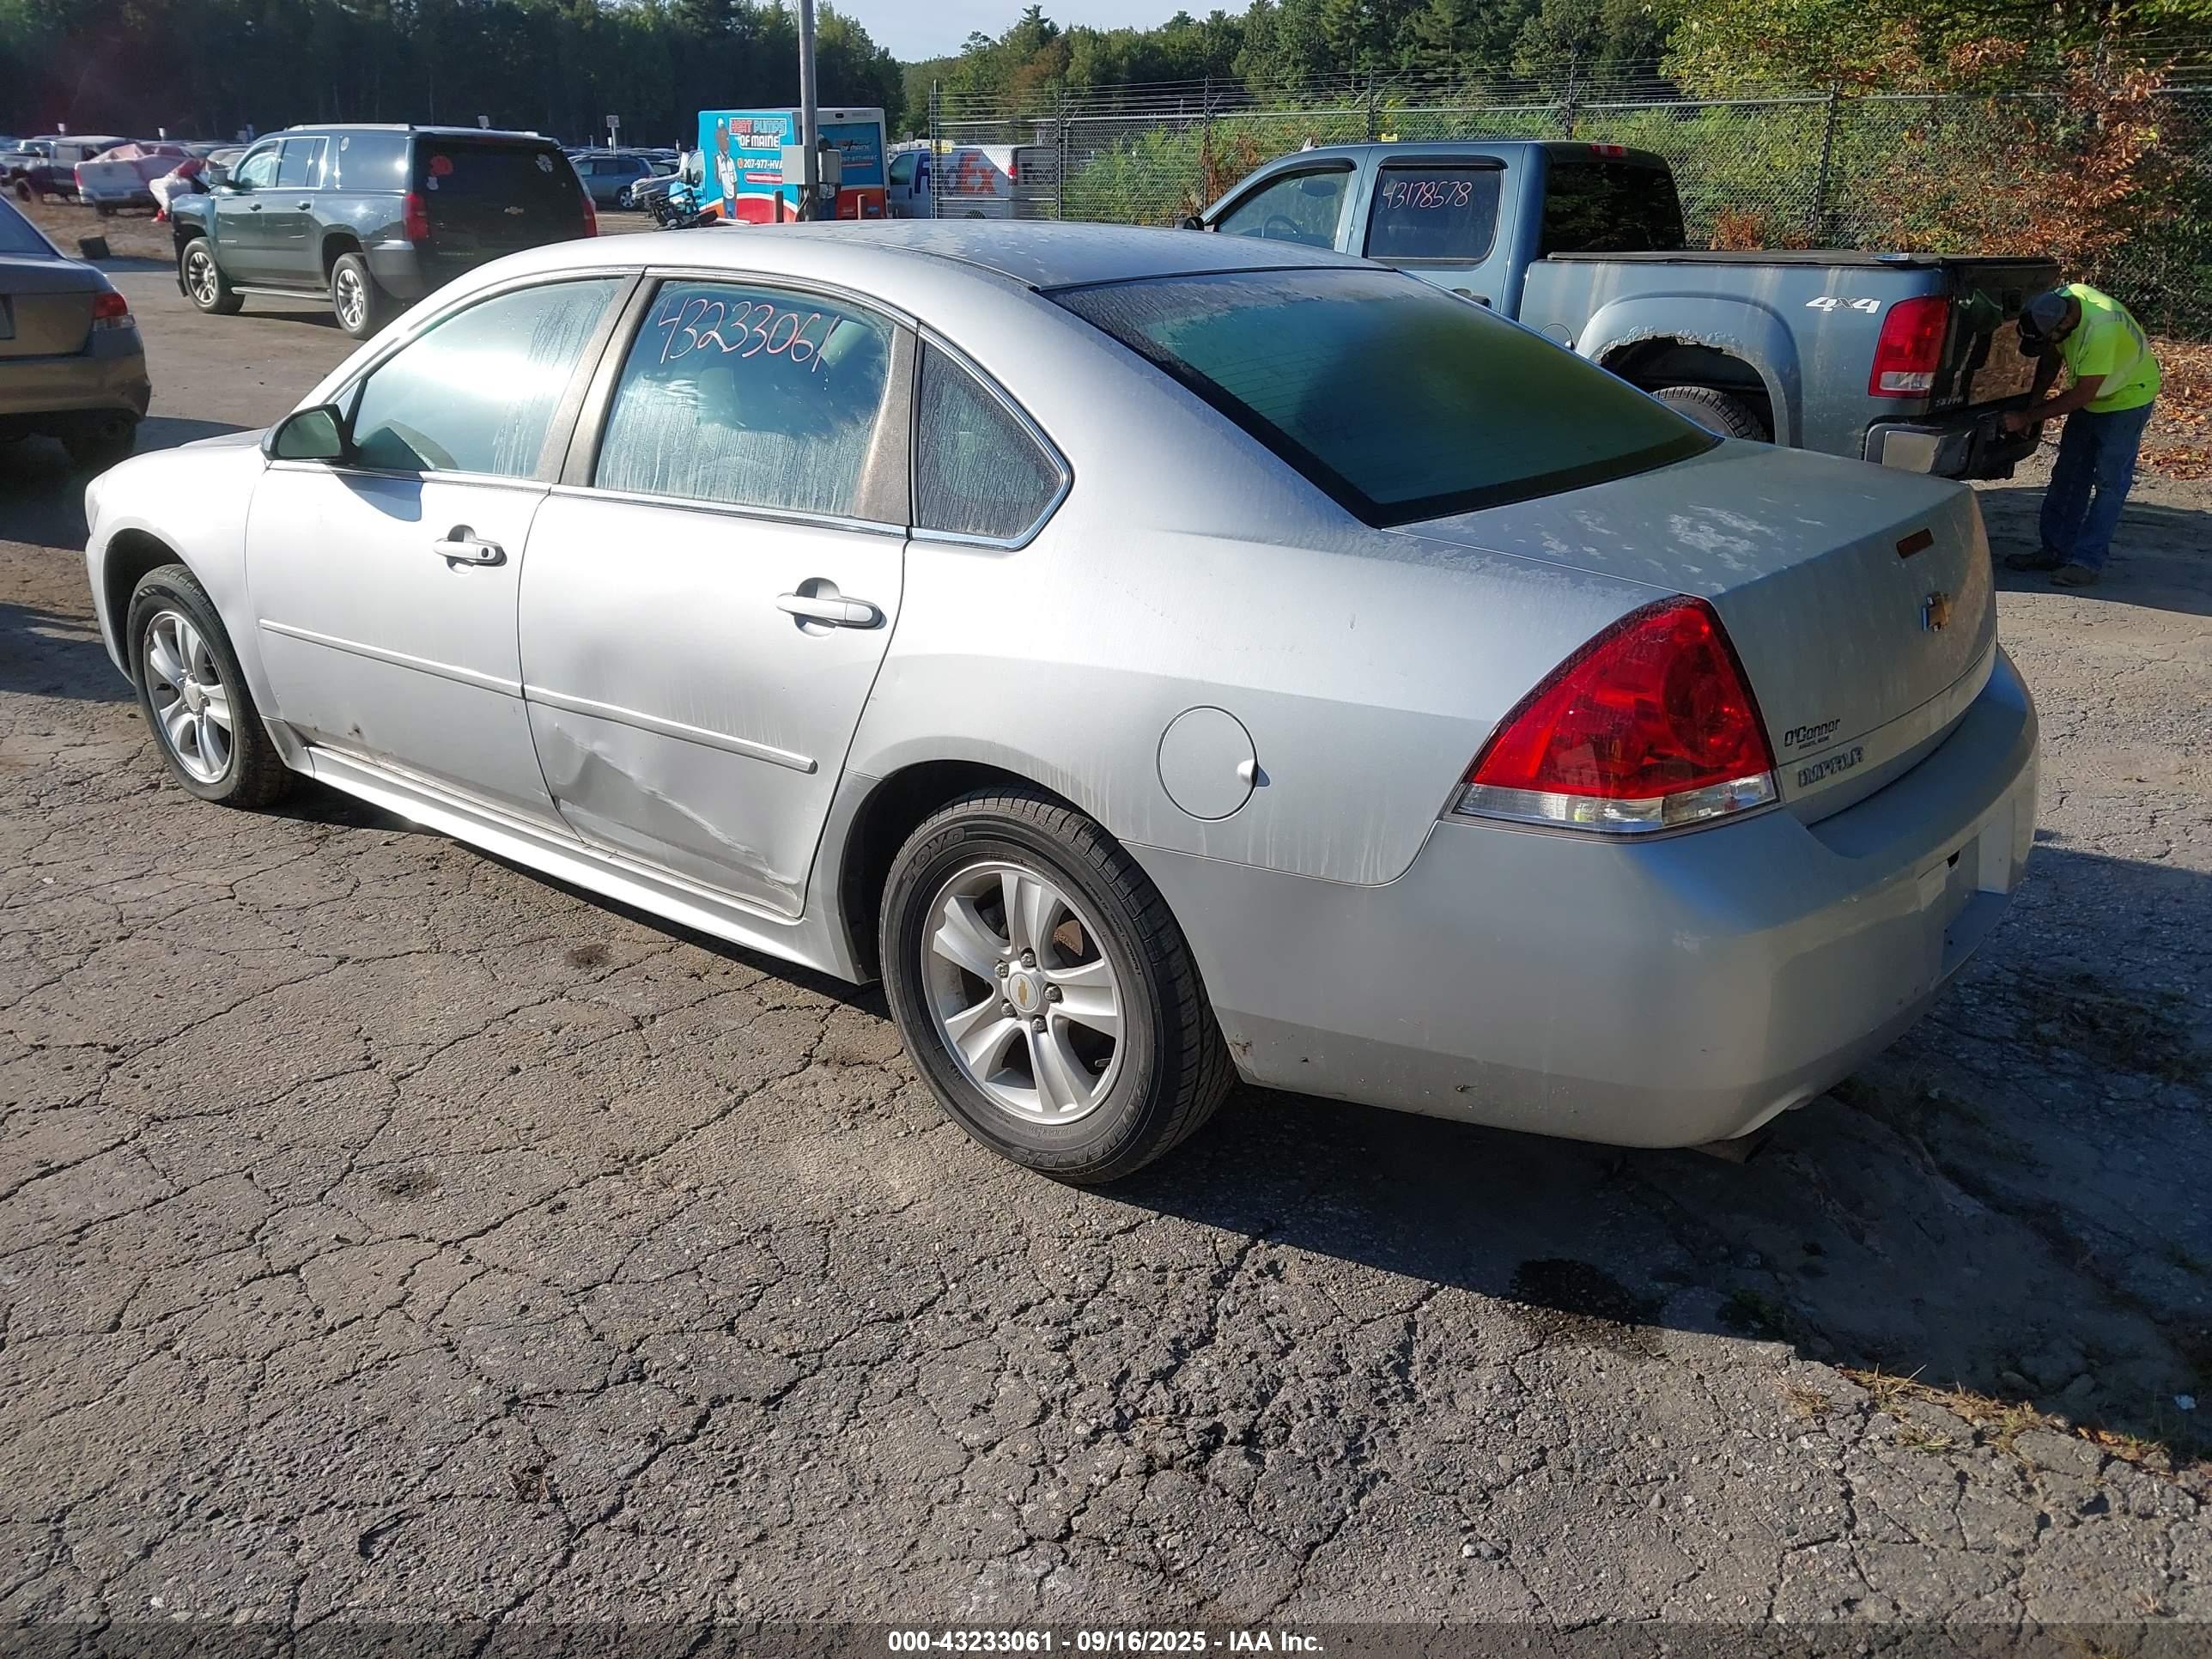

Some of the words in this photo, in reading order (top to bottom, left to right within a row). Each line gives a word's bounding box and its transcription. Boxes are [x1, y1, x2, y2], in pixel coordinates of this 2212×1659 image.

[730, 119, 752, 133] HEAT
[753, 119, 786, 134] PUMPS
[739, 135, 750, 147] OF
[750, 135, 779, 148] MAINE
[1382, 180, 1474, 209] 43178578
[658, 296, 842, 374] 43233061
[1784, 718, 1841, 747] O'Connor
[902, 827, 965, 884] TOYO
